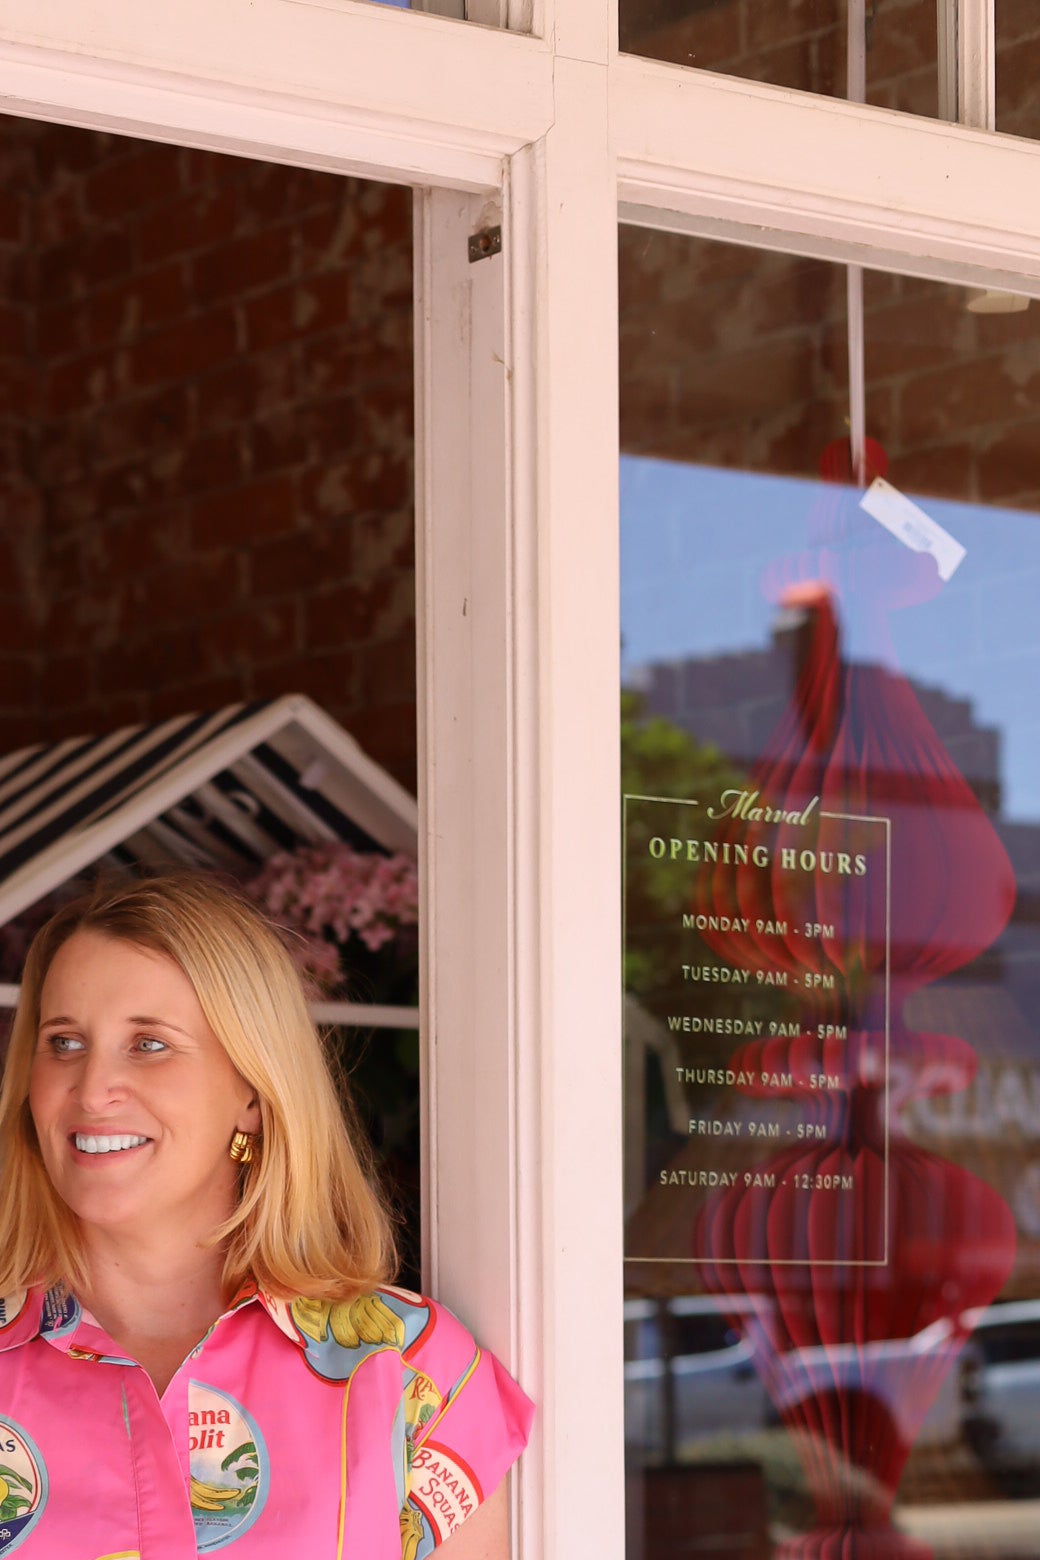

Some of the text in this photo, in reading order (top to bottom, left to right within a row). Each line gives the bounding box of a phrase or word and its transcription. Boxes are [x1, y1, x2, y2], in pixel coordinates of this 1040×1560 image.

[707, 789, 819, 826] Marval
[648, 837, 868, 876] OPENING HOURS
[682, 913, 751, 933] MONDAY
[756, 917, 788, 936] 9AM
[804, 922, 835, 939] 3PM
[682, 965, 750, 984] TUESDAY
[756, 969, 788, 986] 9AM
[804, 972, 835, 990] 5PM
[667, 1016, 763, 1037] WEDNESDAY
[768, 1021, 801, 1038] 9AM
[817, 1024, 847, 1041] 5PM
[675, 1067, 755, 1087] THURSDAY
[761, 1071, 793, 1089] 9AM
[809, 1074, 840, 1090] 5PM
[688, 1119, 742, 1137] FRIDAY
[748, 1121, 780, 1138] 9AM
[797, 1123, 827, 1139] 5PM
[659, 1169, 738, 1187] SATURDAY
[744, 1171, 776, 1188] 9AM
[793, 1173, 854, 1190] 12:30PM
[412, 1449, 474, 1518] BANANA
